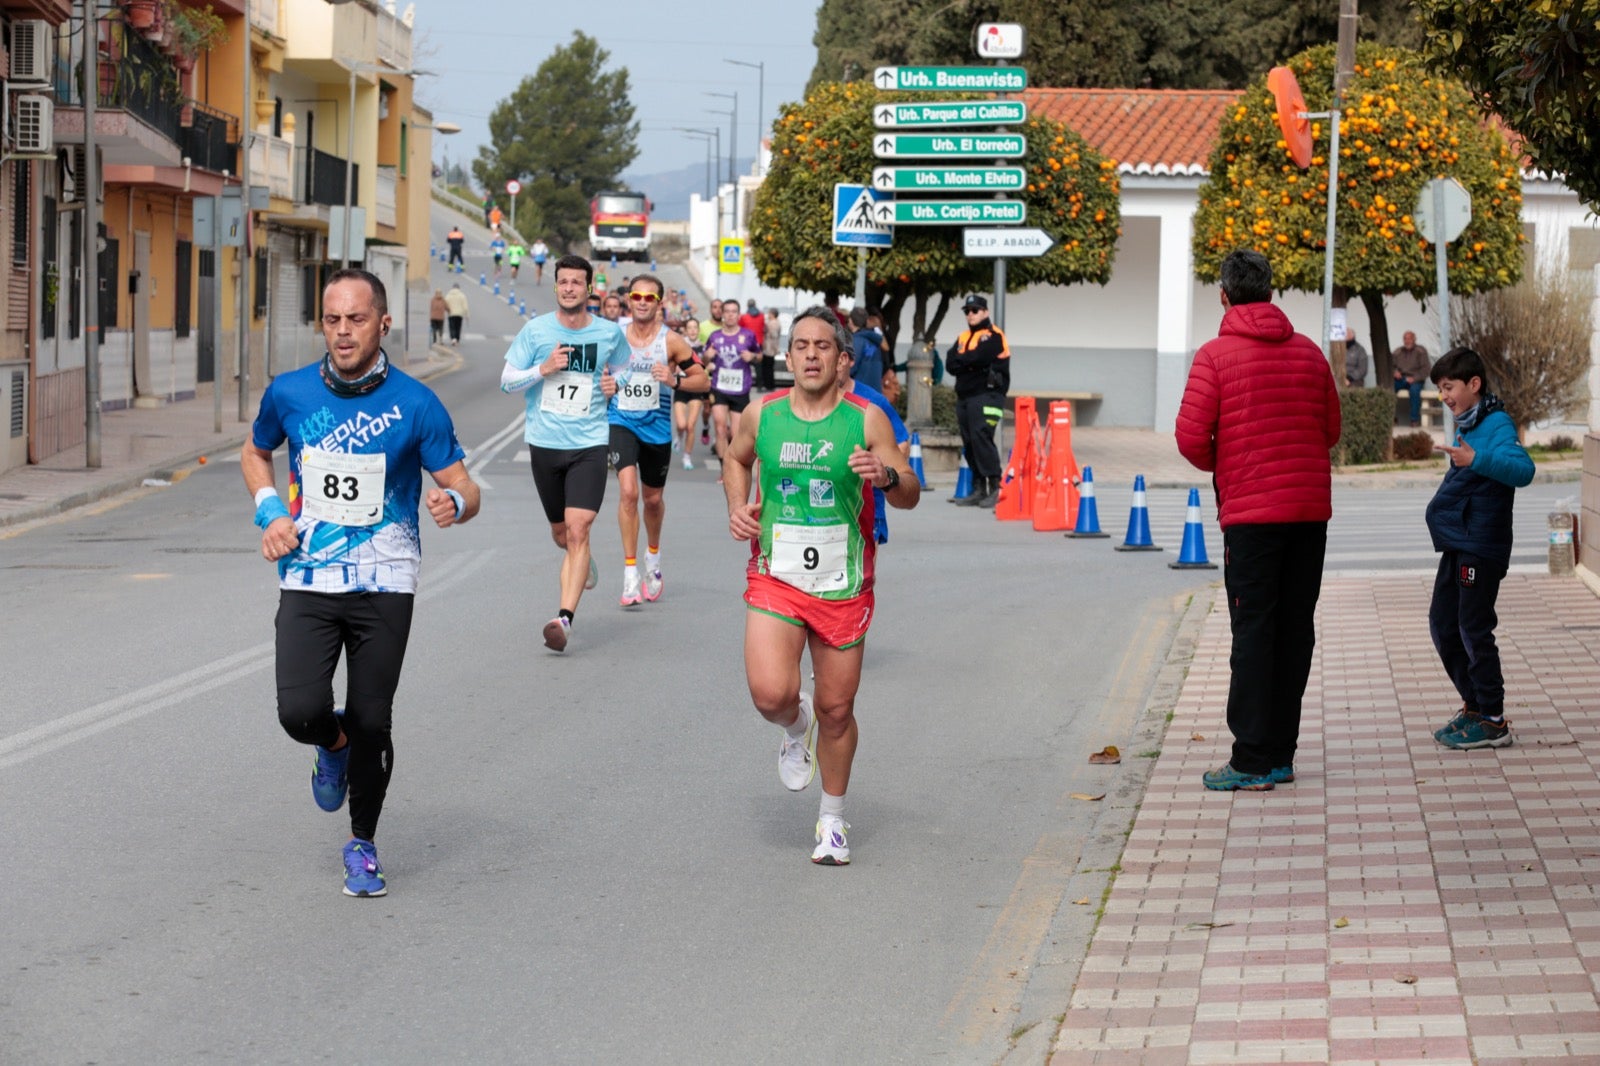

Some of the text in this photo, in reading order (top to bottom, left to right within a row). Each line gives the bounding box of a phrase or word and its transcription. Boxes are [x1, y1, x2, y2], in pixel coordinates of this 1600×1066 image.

[900, 71, 1023, 87] Urb. Buenavista
[898, 105, 1019, 123] Urb. Parque del Cubillas
[932, 139, 1019, 151] Urb. El torreón
[916, 172, 1018, 185] Urb. Monte Elvira
[912, 205, 1019, 221] Urb. Cortijo Pretel
[1003, 237, 1041, 247] ABADÍA
[557, 384, 579, 401] 17
[624, 384, 652, 398] 669
[315, 410, 372, 452] EDIA
[779, 441, 812, 464] ATARFE
[323, 473, 360, 502] 83
[803, 546, 820, 571] 9
